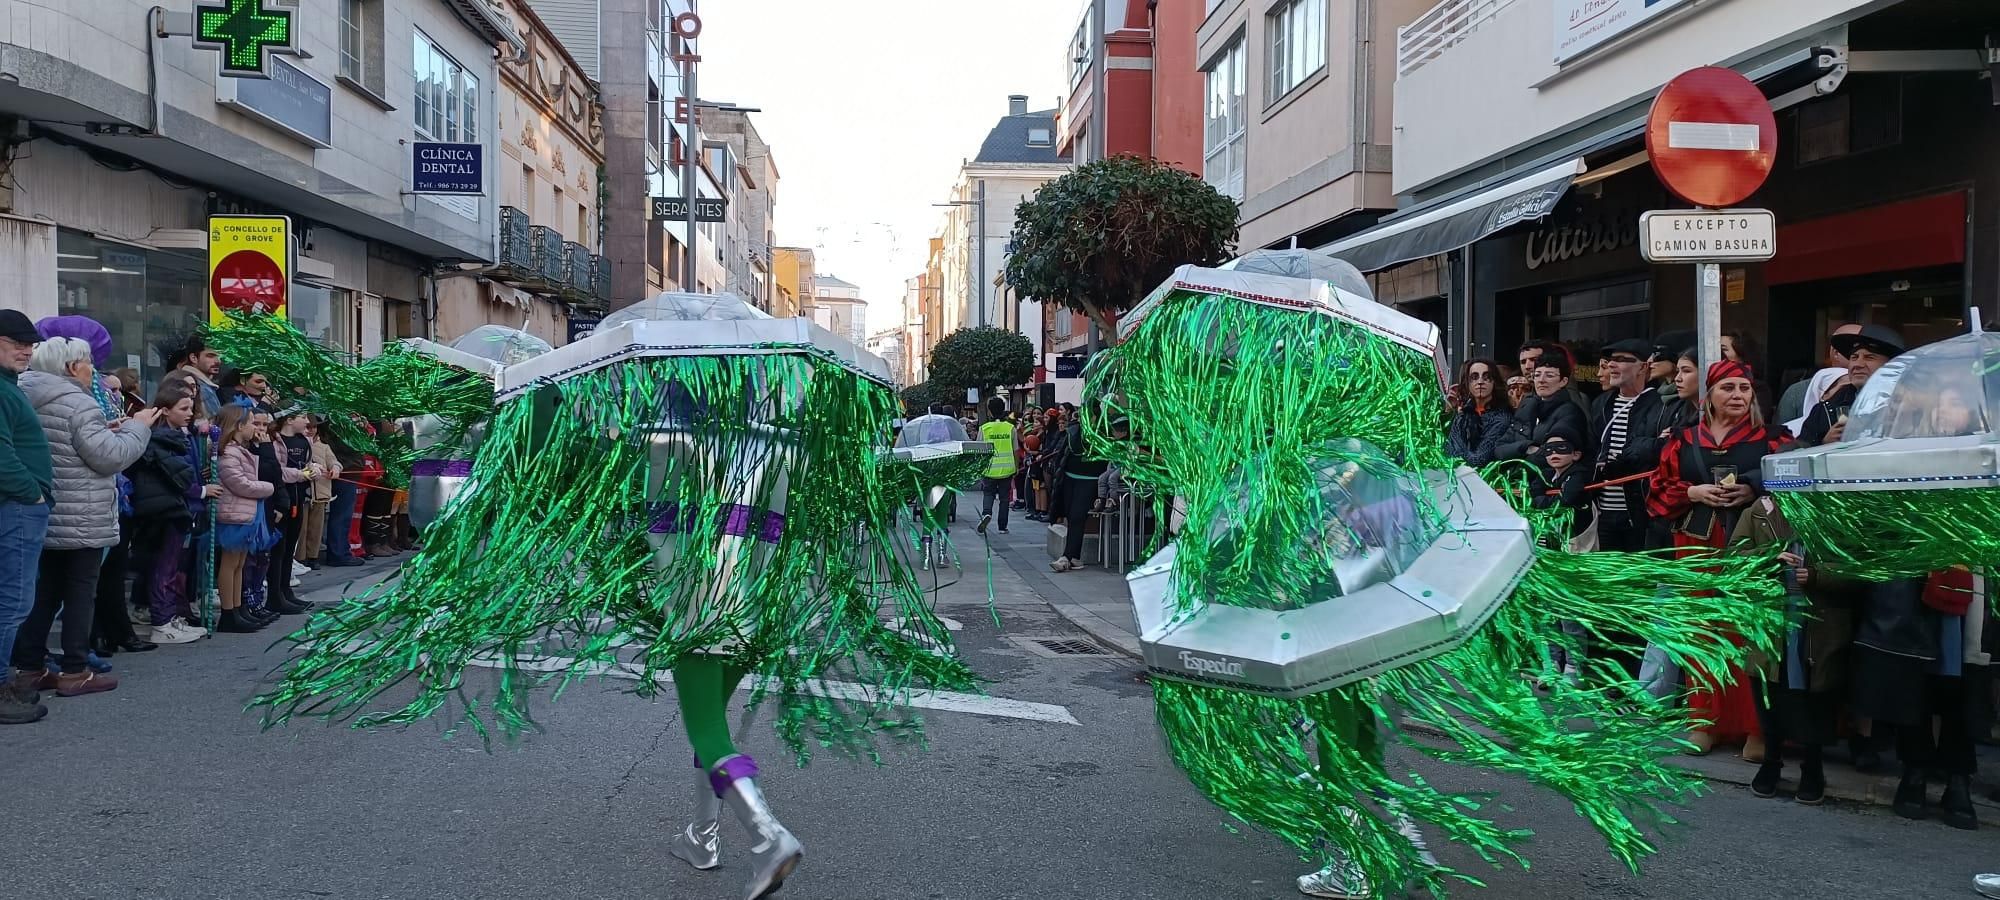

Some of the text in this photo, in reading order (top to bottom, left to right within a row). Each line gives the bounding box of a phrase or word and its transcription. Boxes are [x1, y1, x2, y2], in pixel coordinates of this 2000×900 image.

[271, 62, 297, 89] DENTAL
[420, 147, 474, 161] CLÍNICA
[421, 162, 474, 174] DENTAL
[655, 201, 722, 217] SERANTES
[223, 225, 268, 233] CONCELLO
[1674, 218, 1748, 230] EXCEPTO
[1655, 239, 1768, 251] CAMION BASURA
